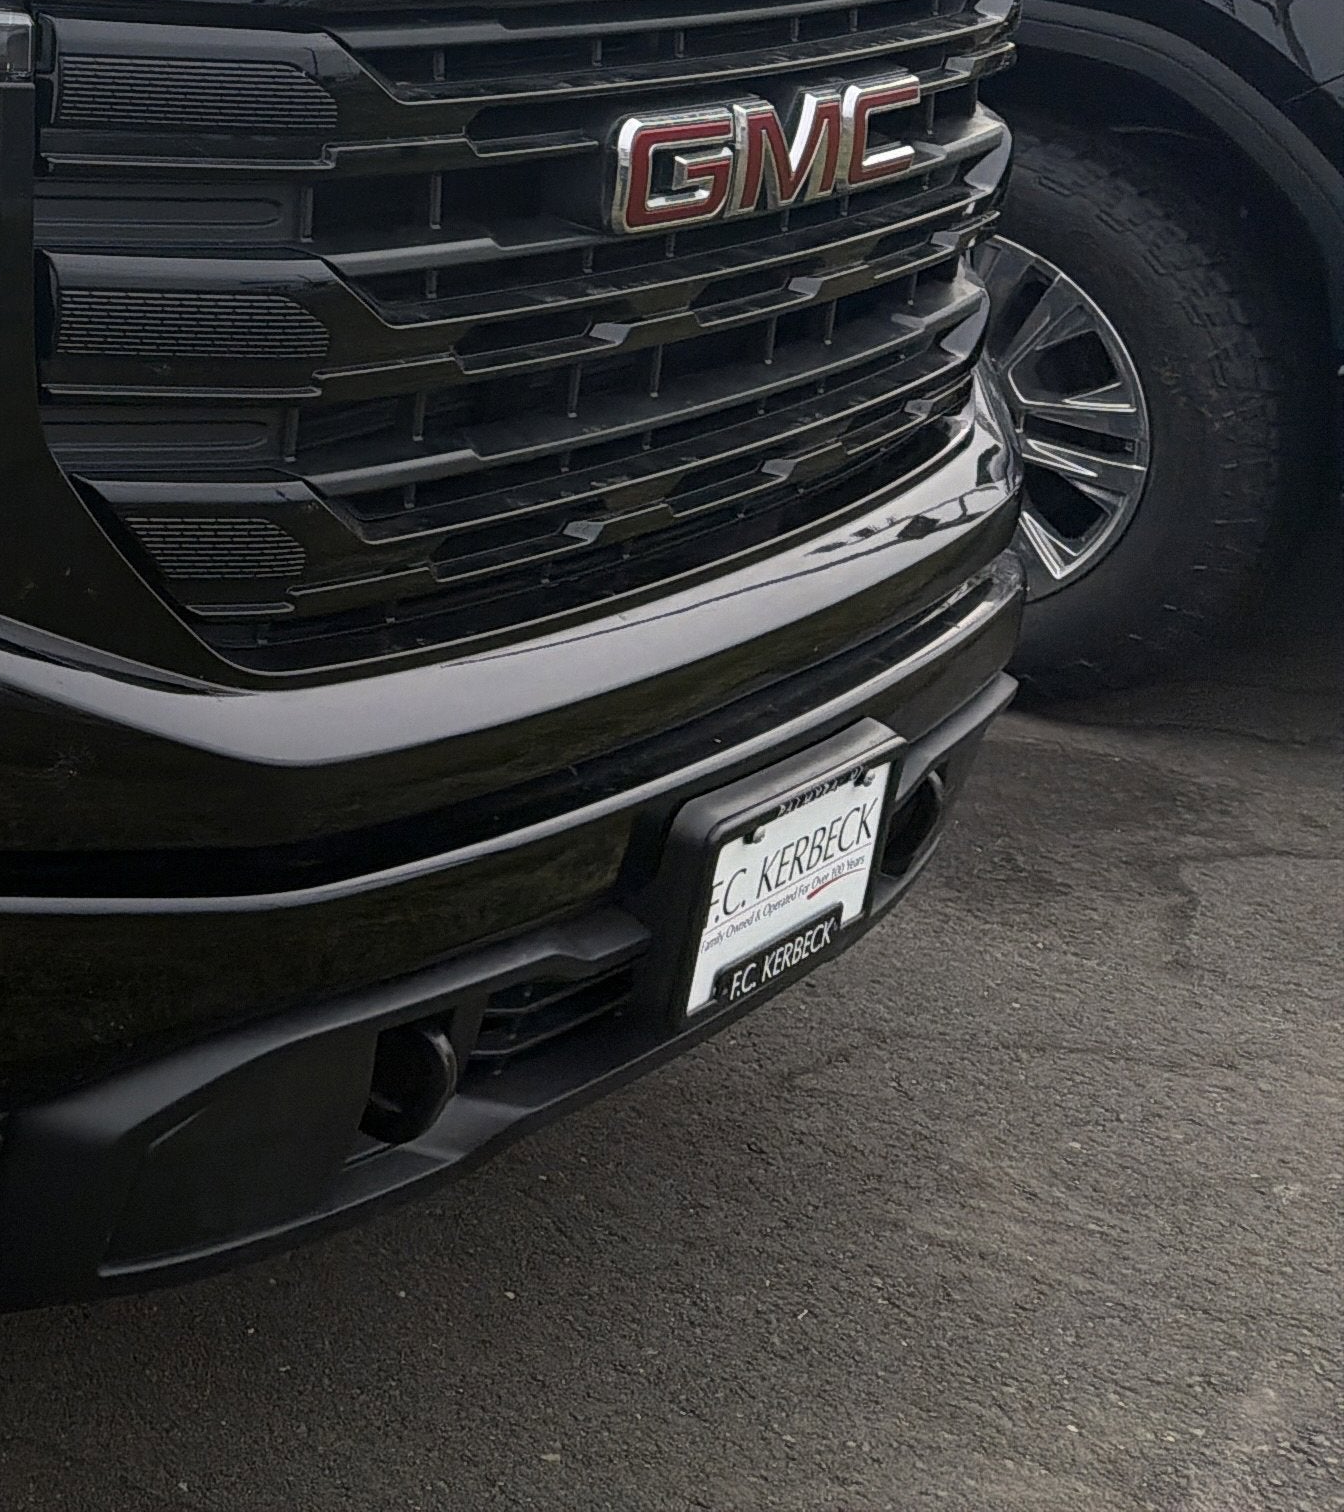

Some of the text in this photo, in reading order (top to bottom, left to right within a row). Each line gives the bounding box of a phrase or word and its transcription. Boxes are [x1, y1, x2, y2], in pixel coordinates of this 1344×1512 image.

[612, 74, 921, 234] GMC
[755, 797, 879, 899] KERBECK
[701, 931, 725, 953] Family
[726, 910, 754, 938] Owned
[762, 886, 799, 916] Operated
[798, 883, 811, 897] For
[811, 872, 830, 890] Over
[846, 855, 866, 871] Years
[729, 917, 835, 1001] F.C. KERBECK
